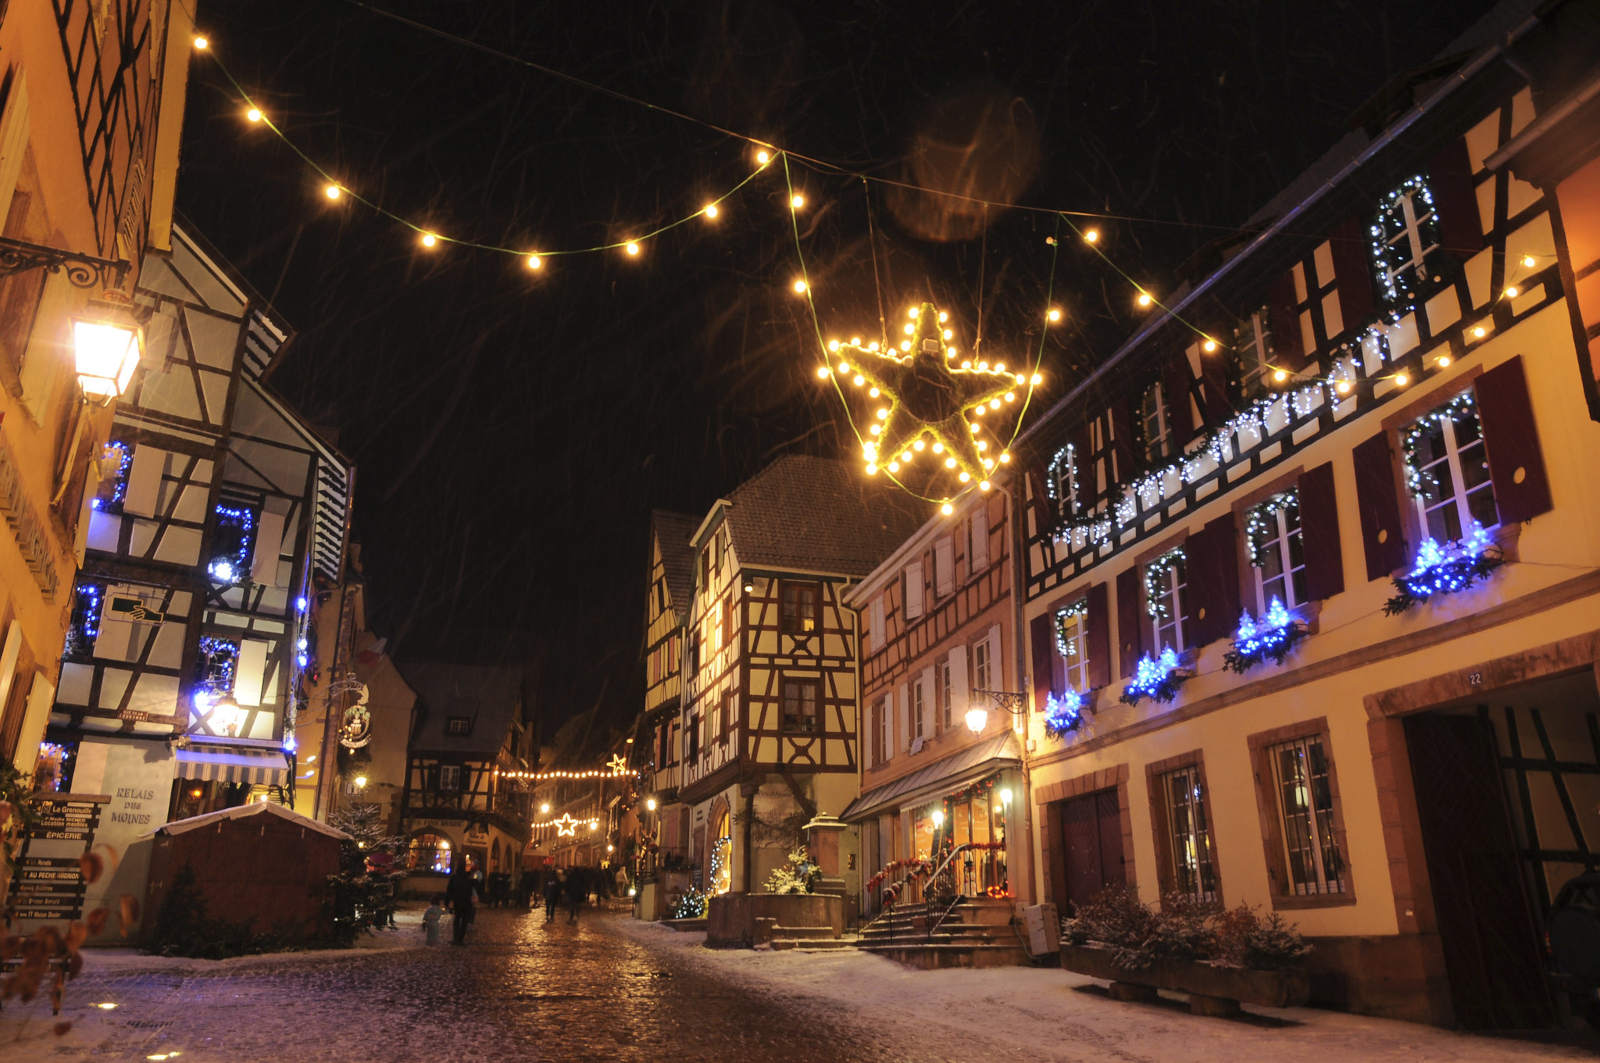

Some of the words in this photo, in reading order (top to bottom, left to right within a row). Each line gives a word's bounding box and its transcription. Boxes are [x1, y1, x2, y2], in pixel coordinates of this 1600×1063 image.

[1470, 673, 1481, 685] 22
[116, 787, 154, 800] RELAIS
[111, 812, 151, 825] MOINES
